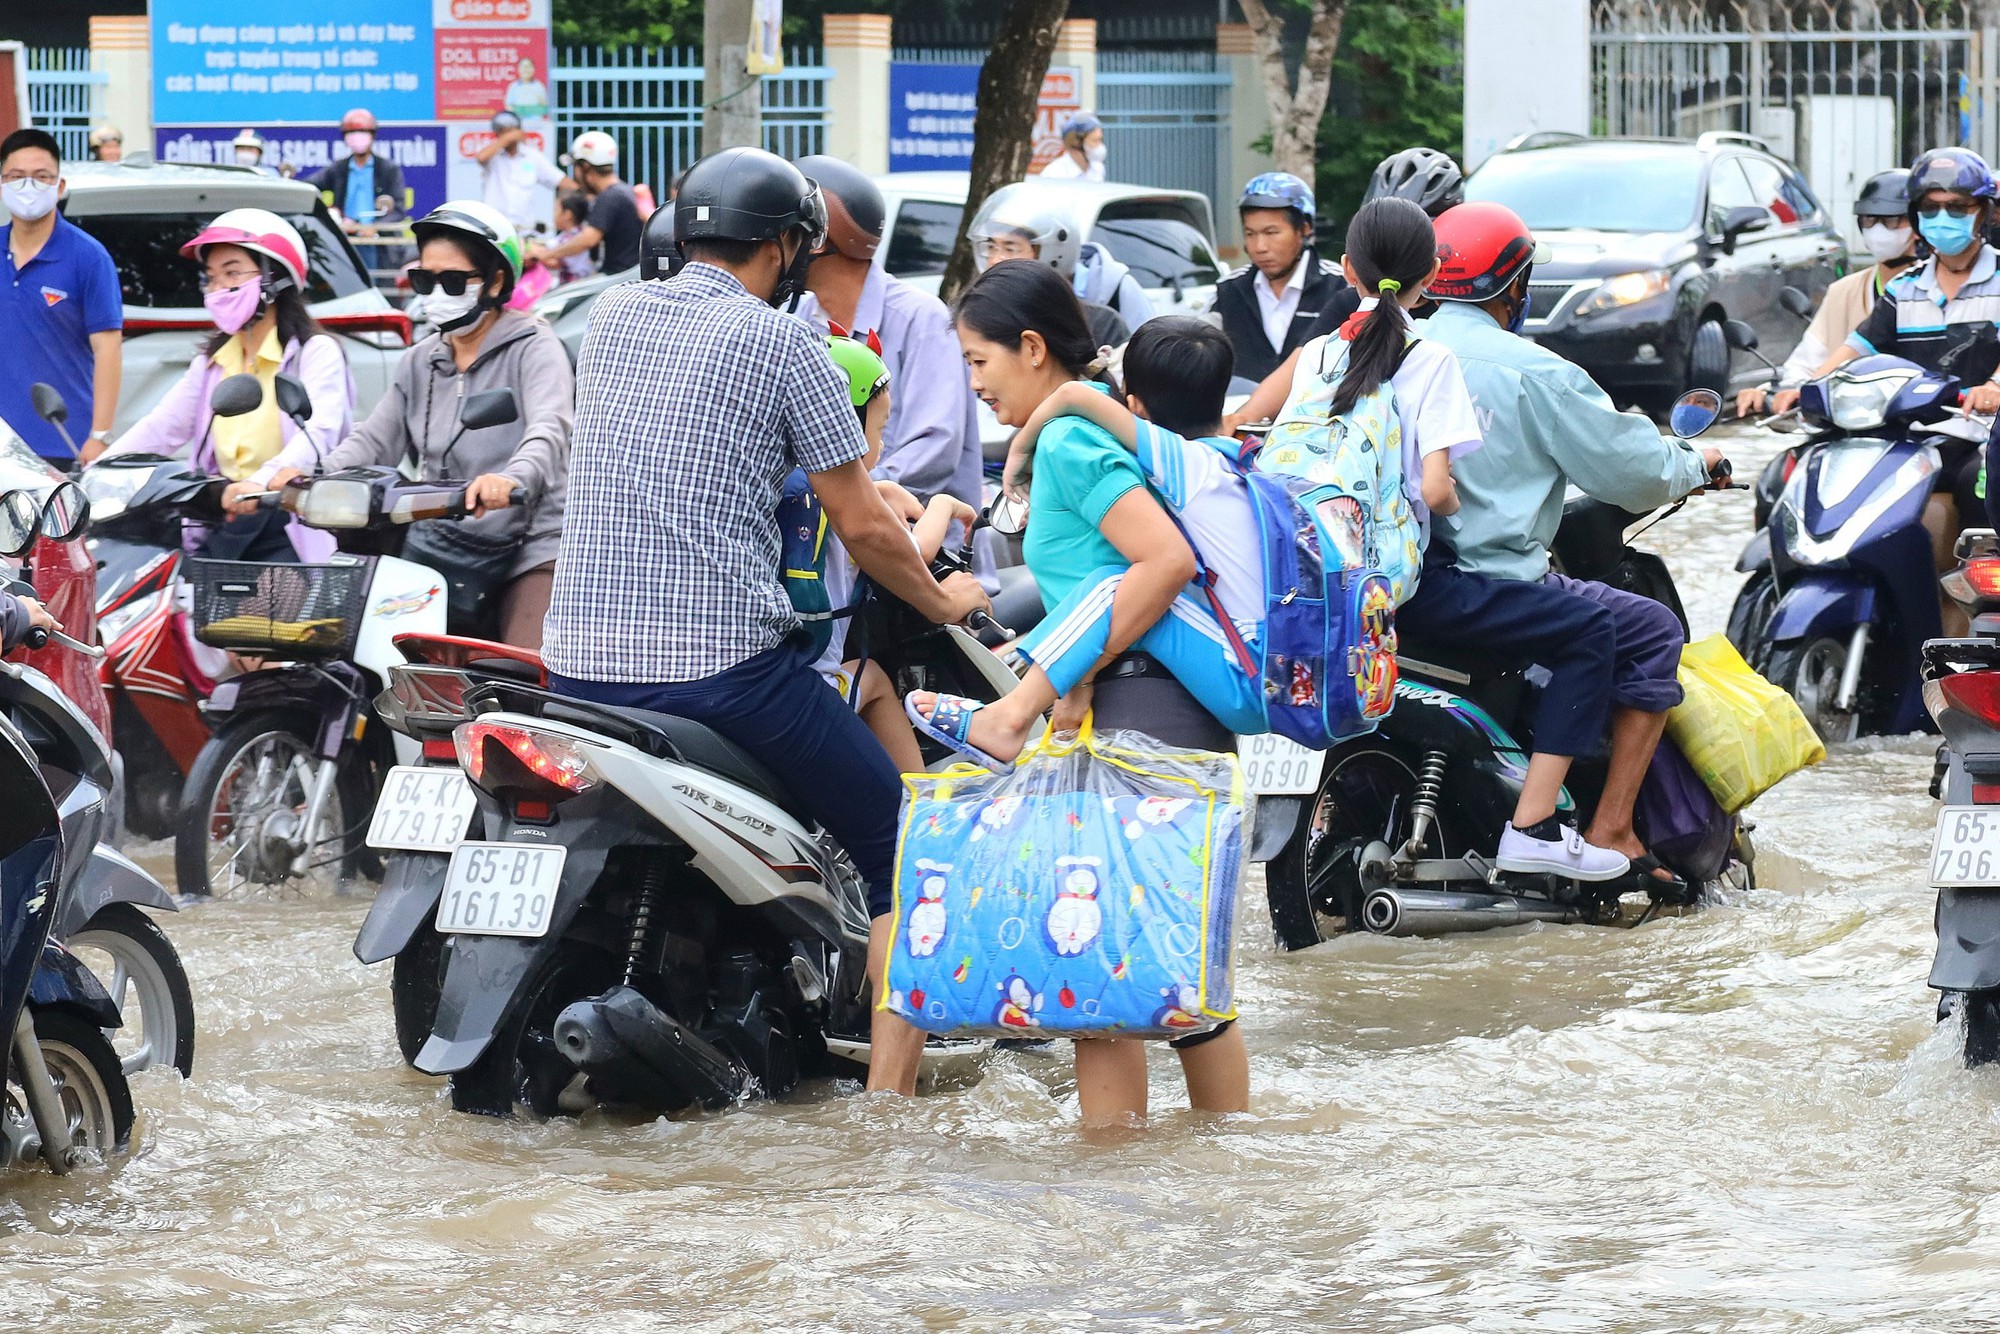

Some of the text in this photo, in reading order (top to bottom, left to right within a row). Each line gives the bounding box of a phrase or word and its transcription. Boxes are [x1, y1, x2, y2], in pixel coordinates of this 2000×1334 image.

[478, 47, 518, 63] IELTS
[1247, 760, 1309, 788] 9690
[377, 809, 464, 844] 179.13
[672, 785, 777, 837] AIR BLADE
[513, 829, 547, 838] HONDA
[450, 890, 546, 928] 161.39
